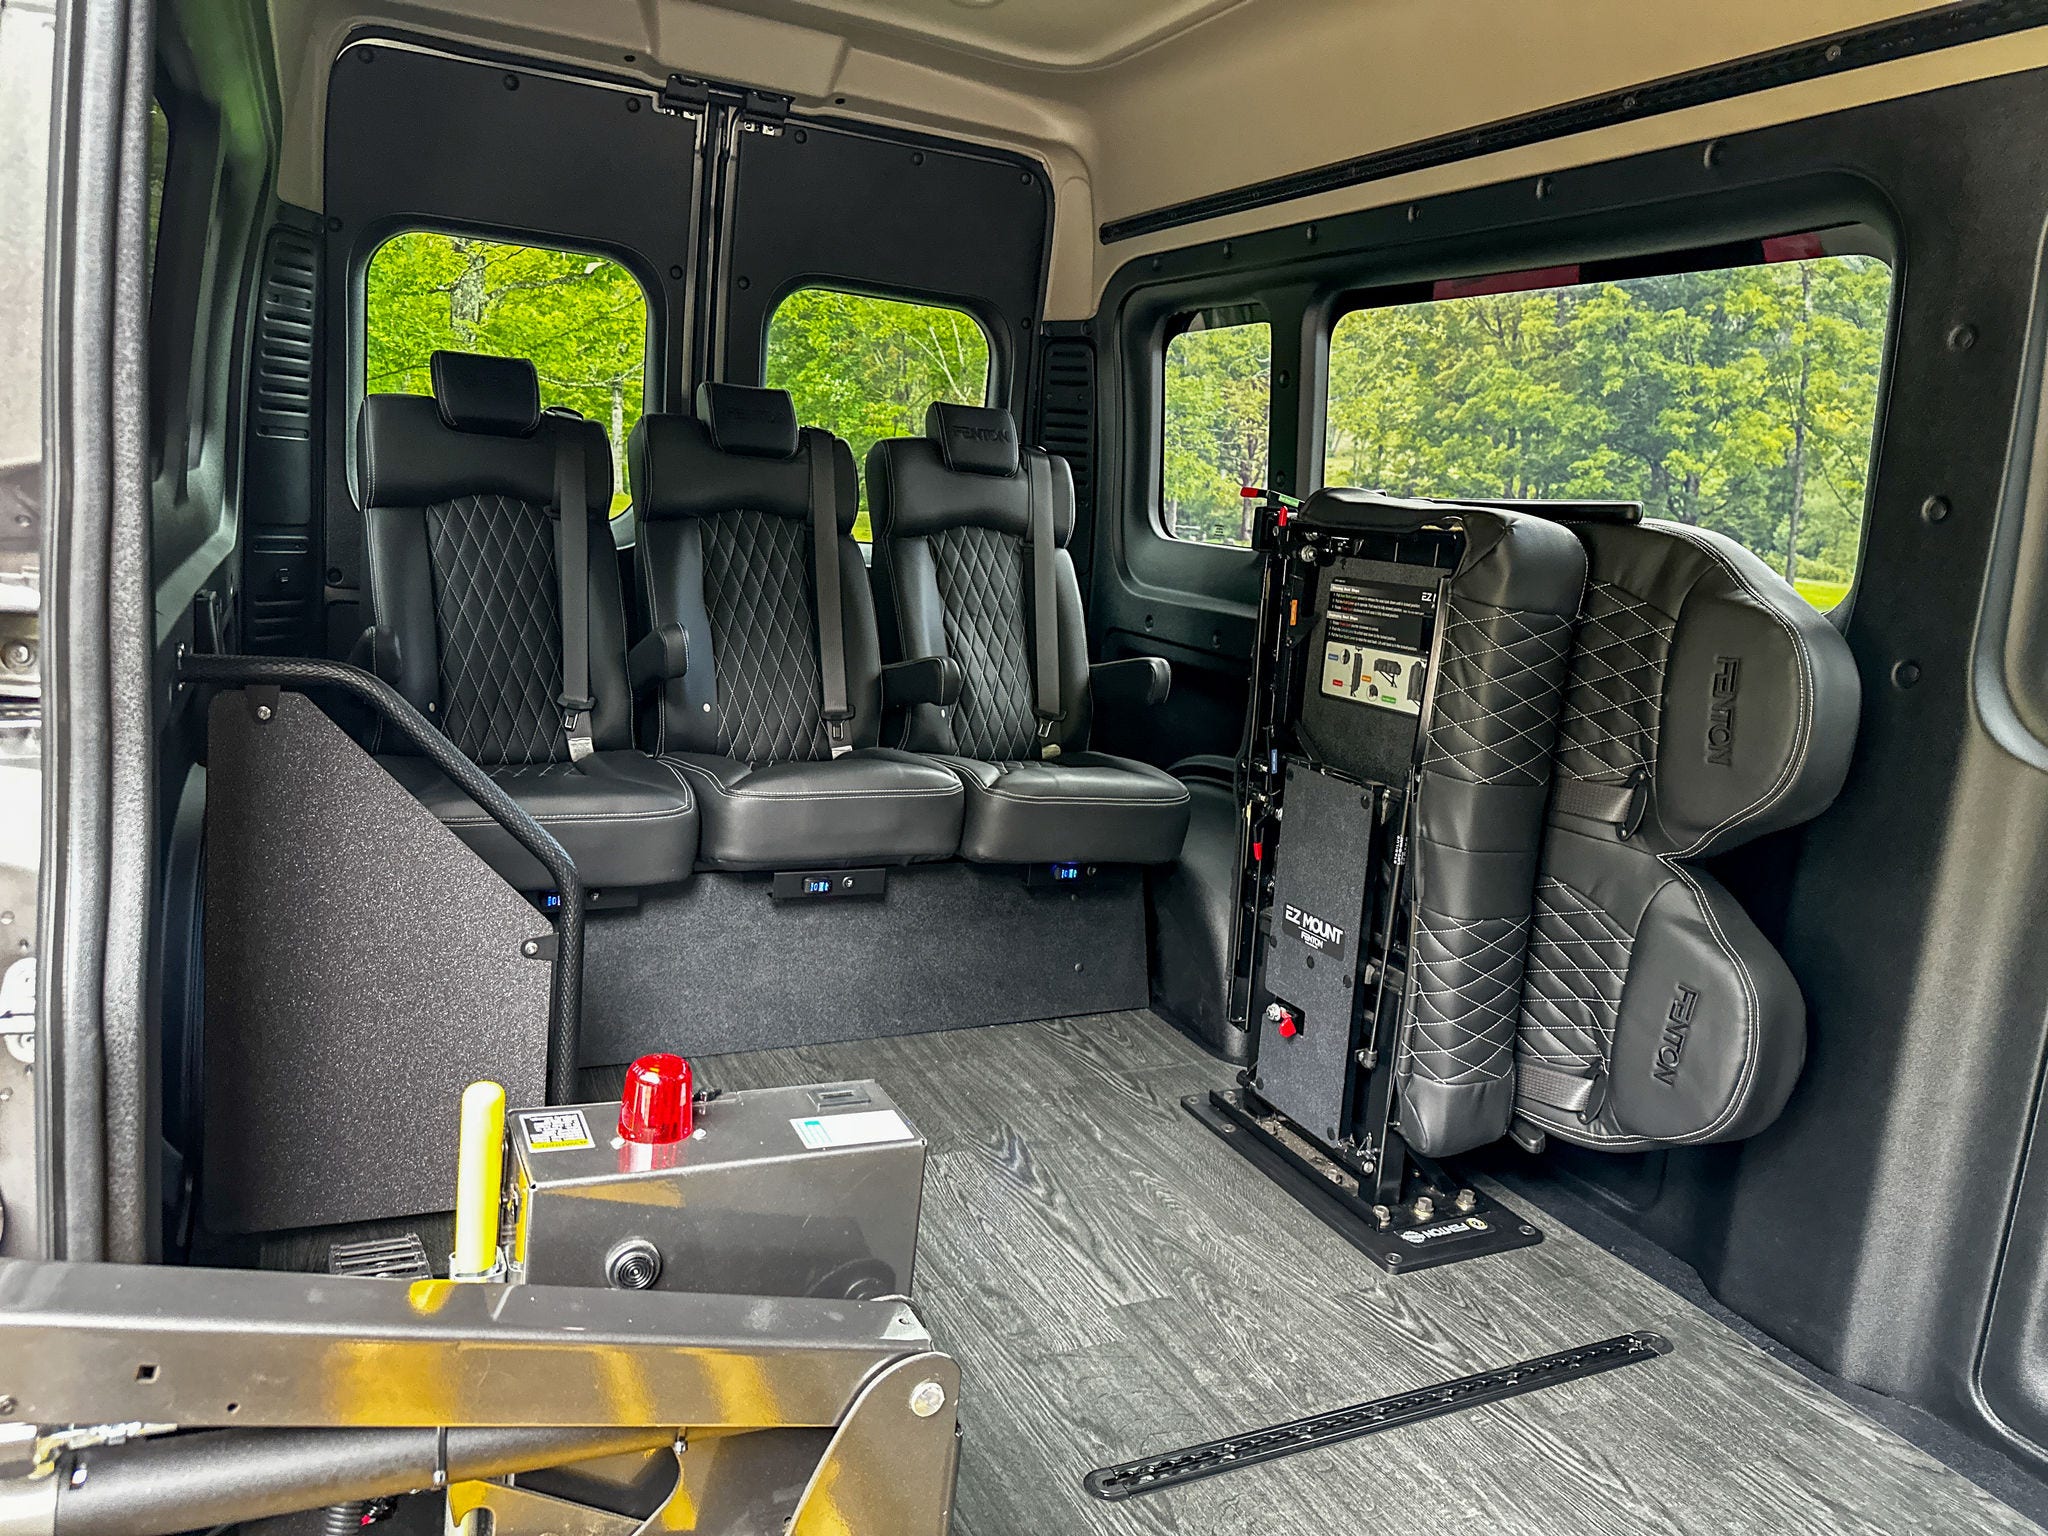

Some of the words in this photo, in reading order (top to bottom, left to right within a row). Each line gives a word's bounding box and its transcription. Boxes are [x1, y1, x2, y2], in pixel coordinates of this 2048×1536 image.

[951, 425, 1010, 444] FENTON
[1707, 656, 1740, 766] FENTON
[1285, 904, 1302, 925] EZ
[1302, 912, 1344, 945] MOUNT
[1300, 931, 1324, 949] FENTON
[1653, 984, 1699, 1086] FENTON
[1421, 1222, 1471, 1239] FENTON
